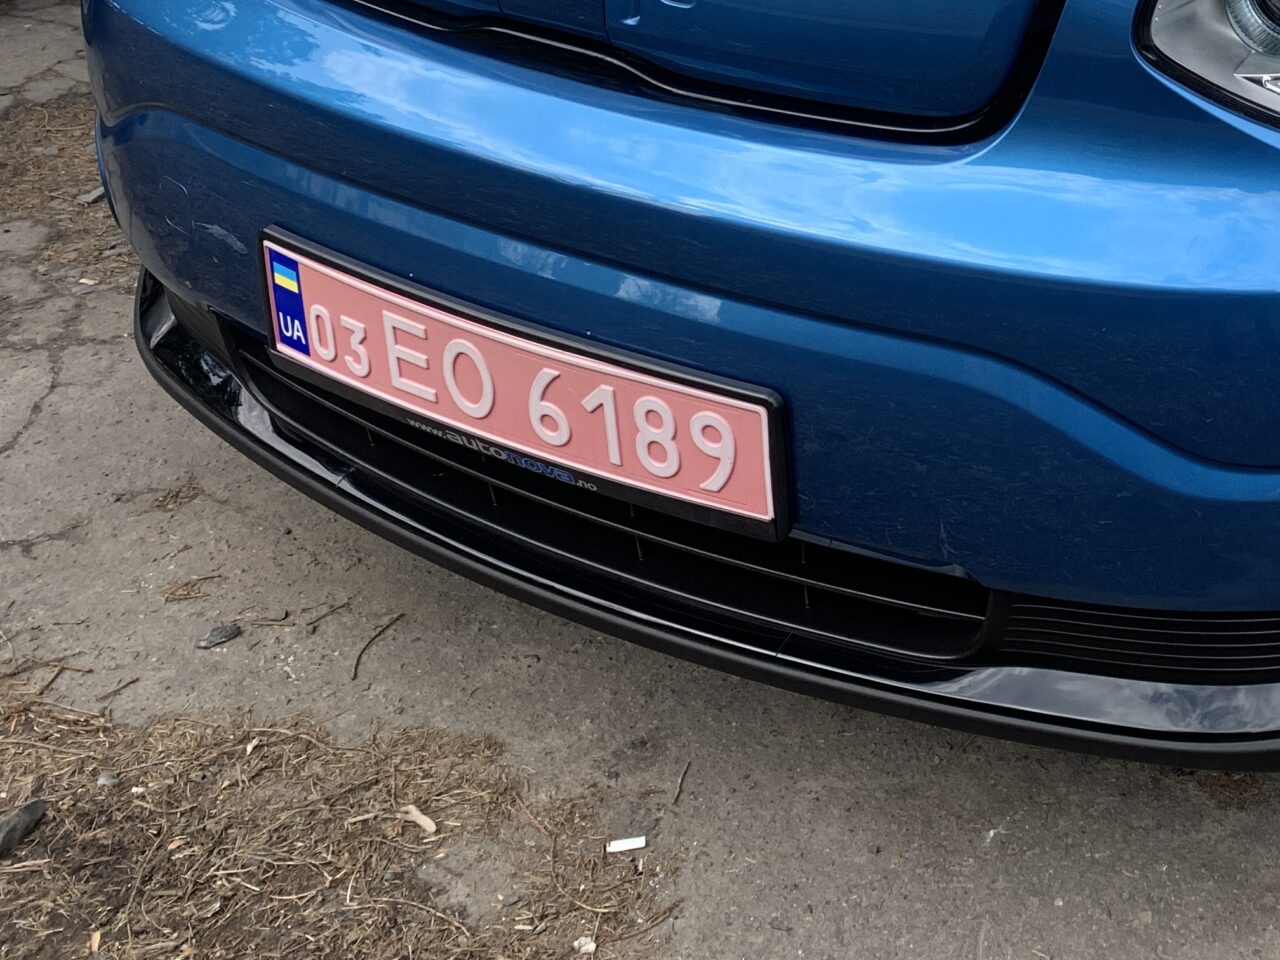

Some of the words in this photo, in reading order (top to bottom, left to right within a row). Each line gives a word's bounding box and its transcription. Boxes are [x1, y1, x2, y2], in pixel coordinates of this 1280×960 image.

[279, 311, 306, 345] UA
[406, 417, 598, 491] www.autonova.no
[527, 367, 737, 493] 6189
